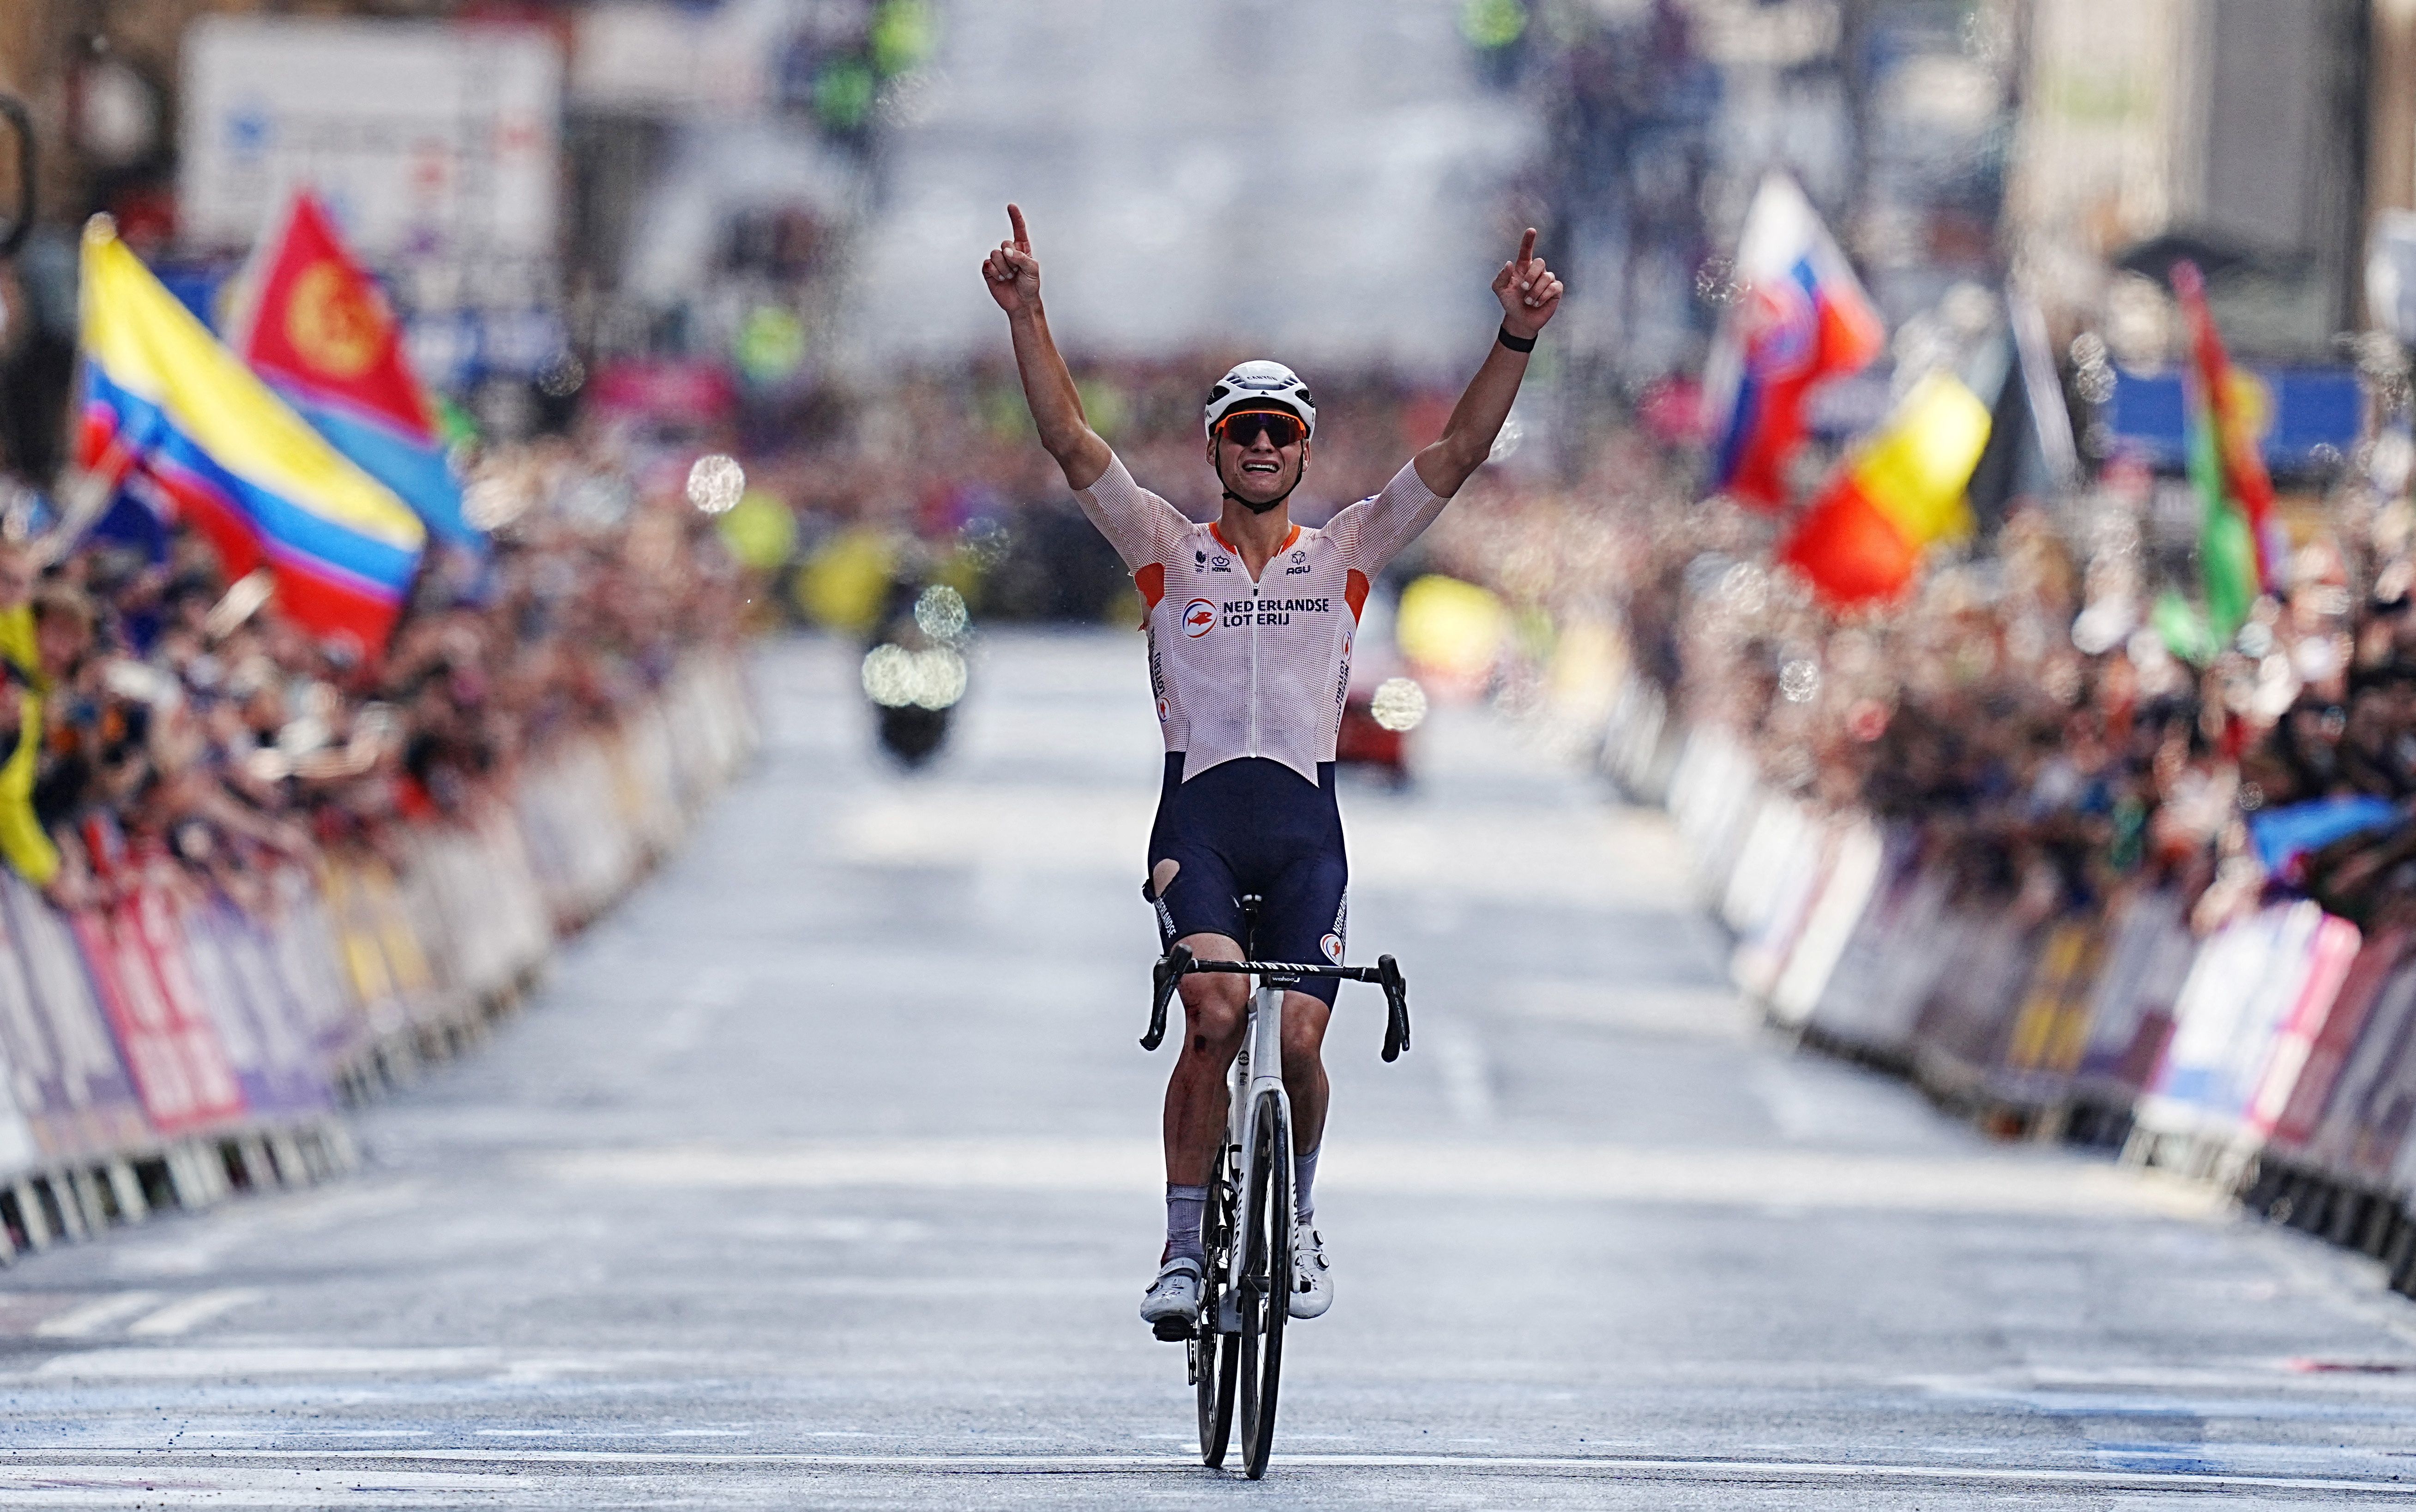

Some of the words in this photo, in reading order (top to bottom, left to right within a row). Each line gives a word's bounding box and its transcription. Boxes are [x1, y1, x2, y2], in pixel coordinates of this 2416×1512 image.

[1286, 565, 1310, 575] AGU
[1223, 598, 1329, 613] NEDERLANDSE
[1223, 613, 1289, 627] LOTERIJ
